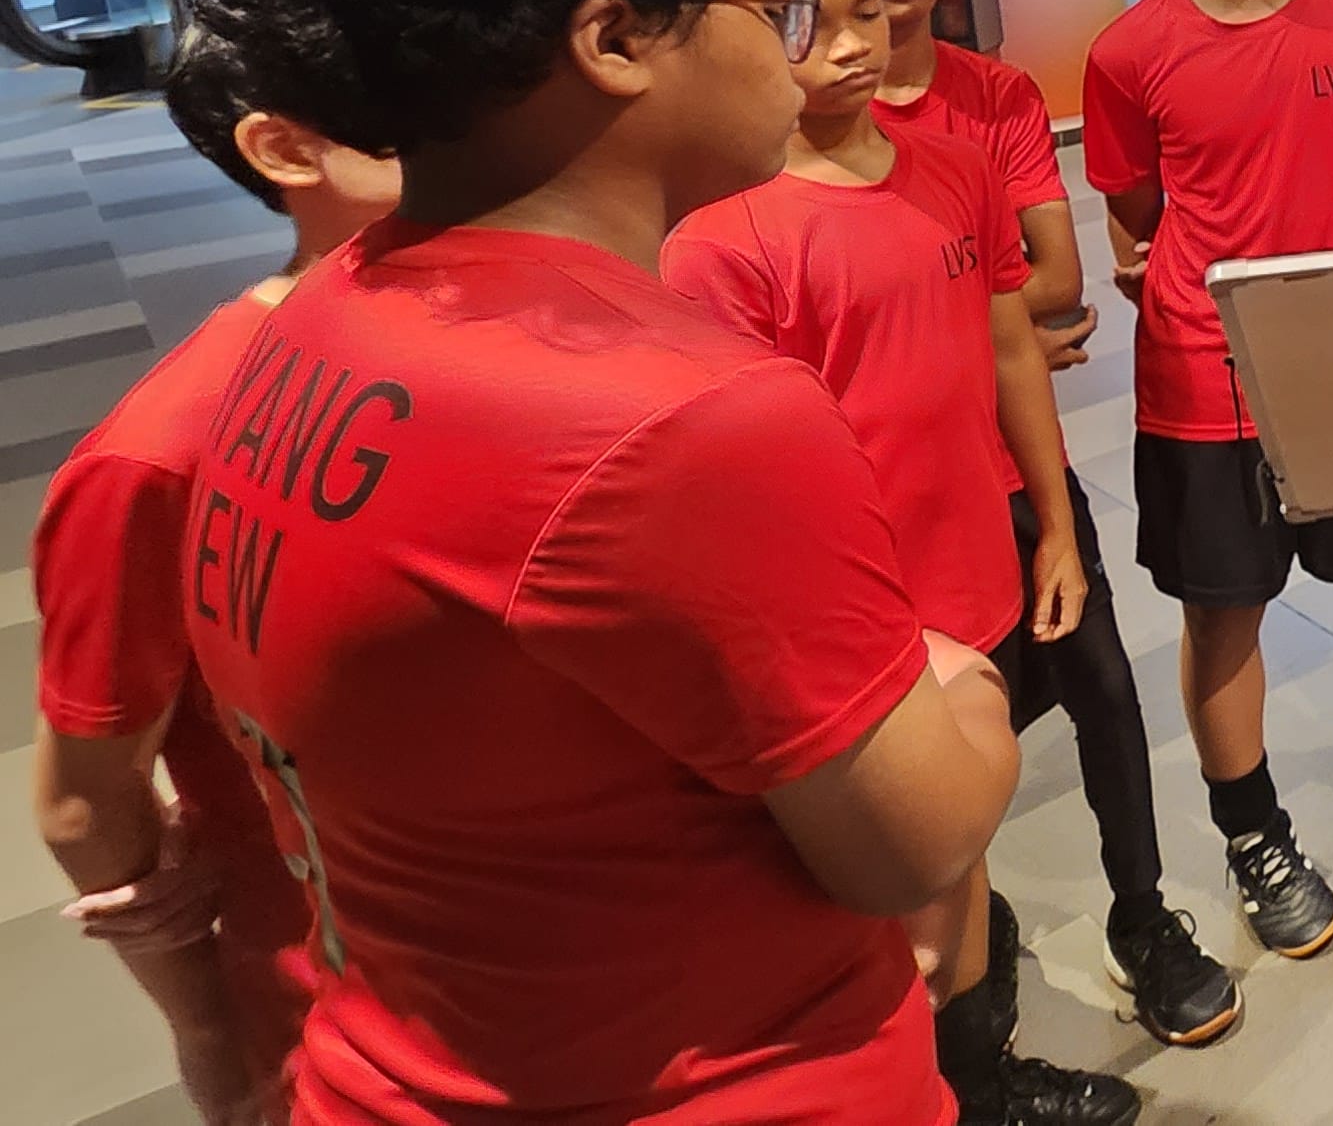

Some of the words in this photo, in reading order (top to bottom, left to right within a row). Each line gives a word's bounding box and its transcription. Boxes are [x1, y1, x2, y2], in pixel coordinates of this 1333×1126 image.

[940, 235, 978, 280] LVS
[208, 320, 414, 523] YANG
[195, 489, 284, 657] EW
